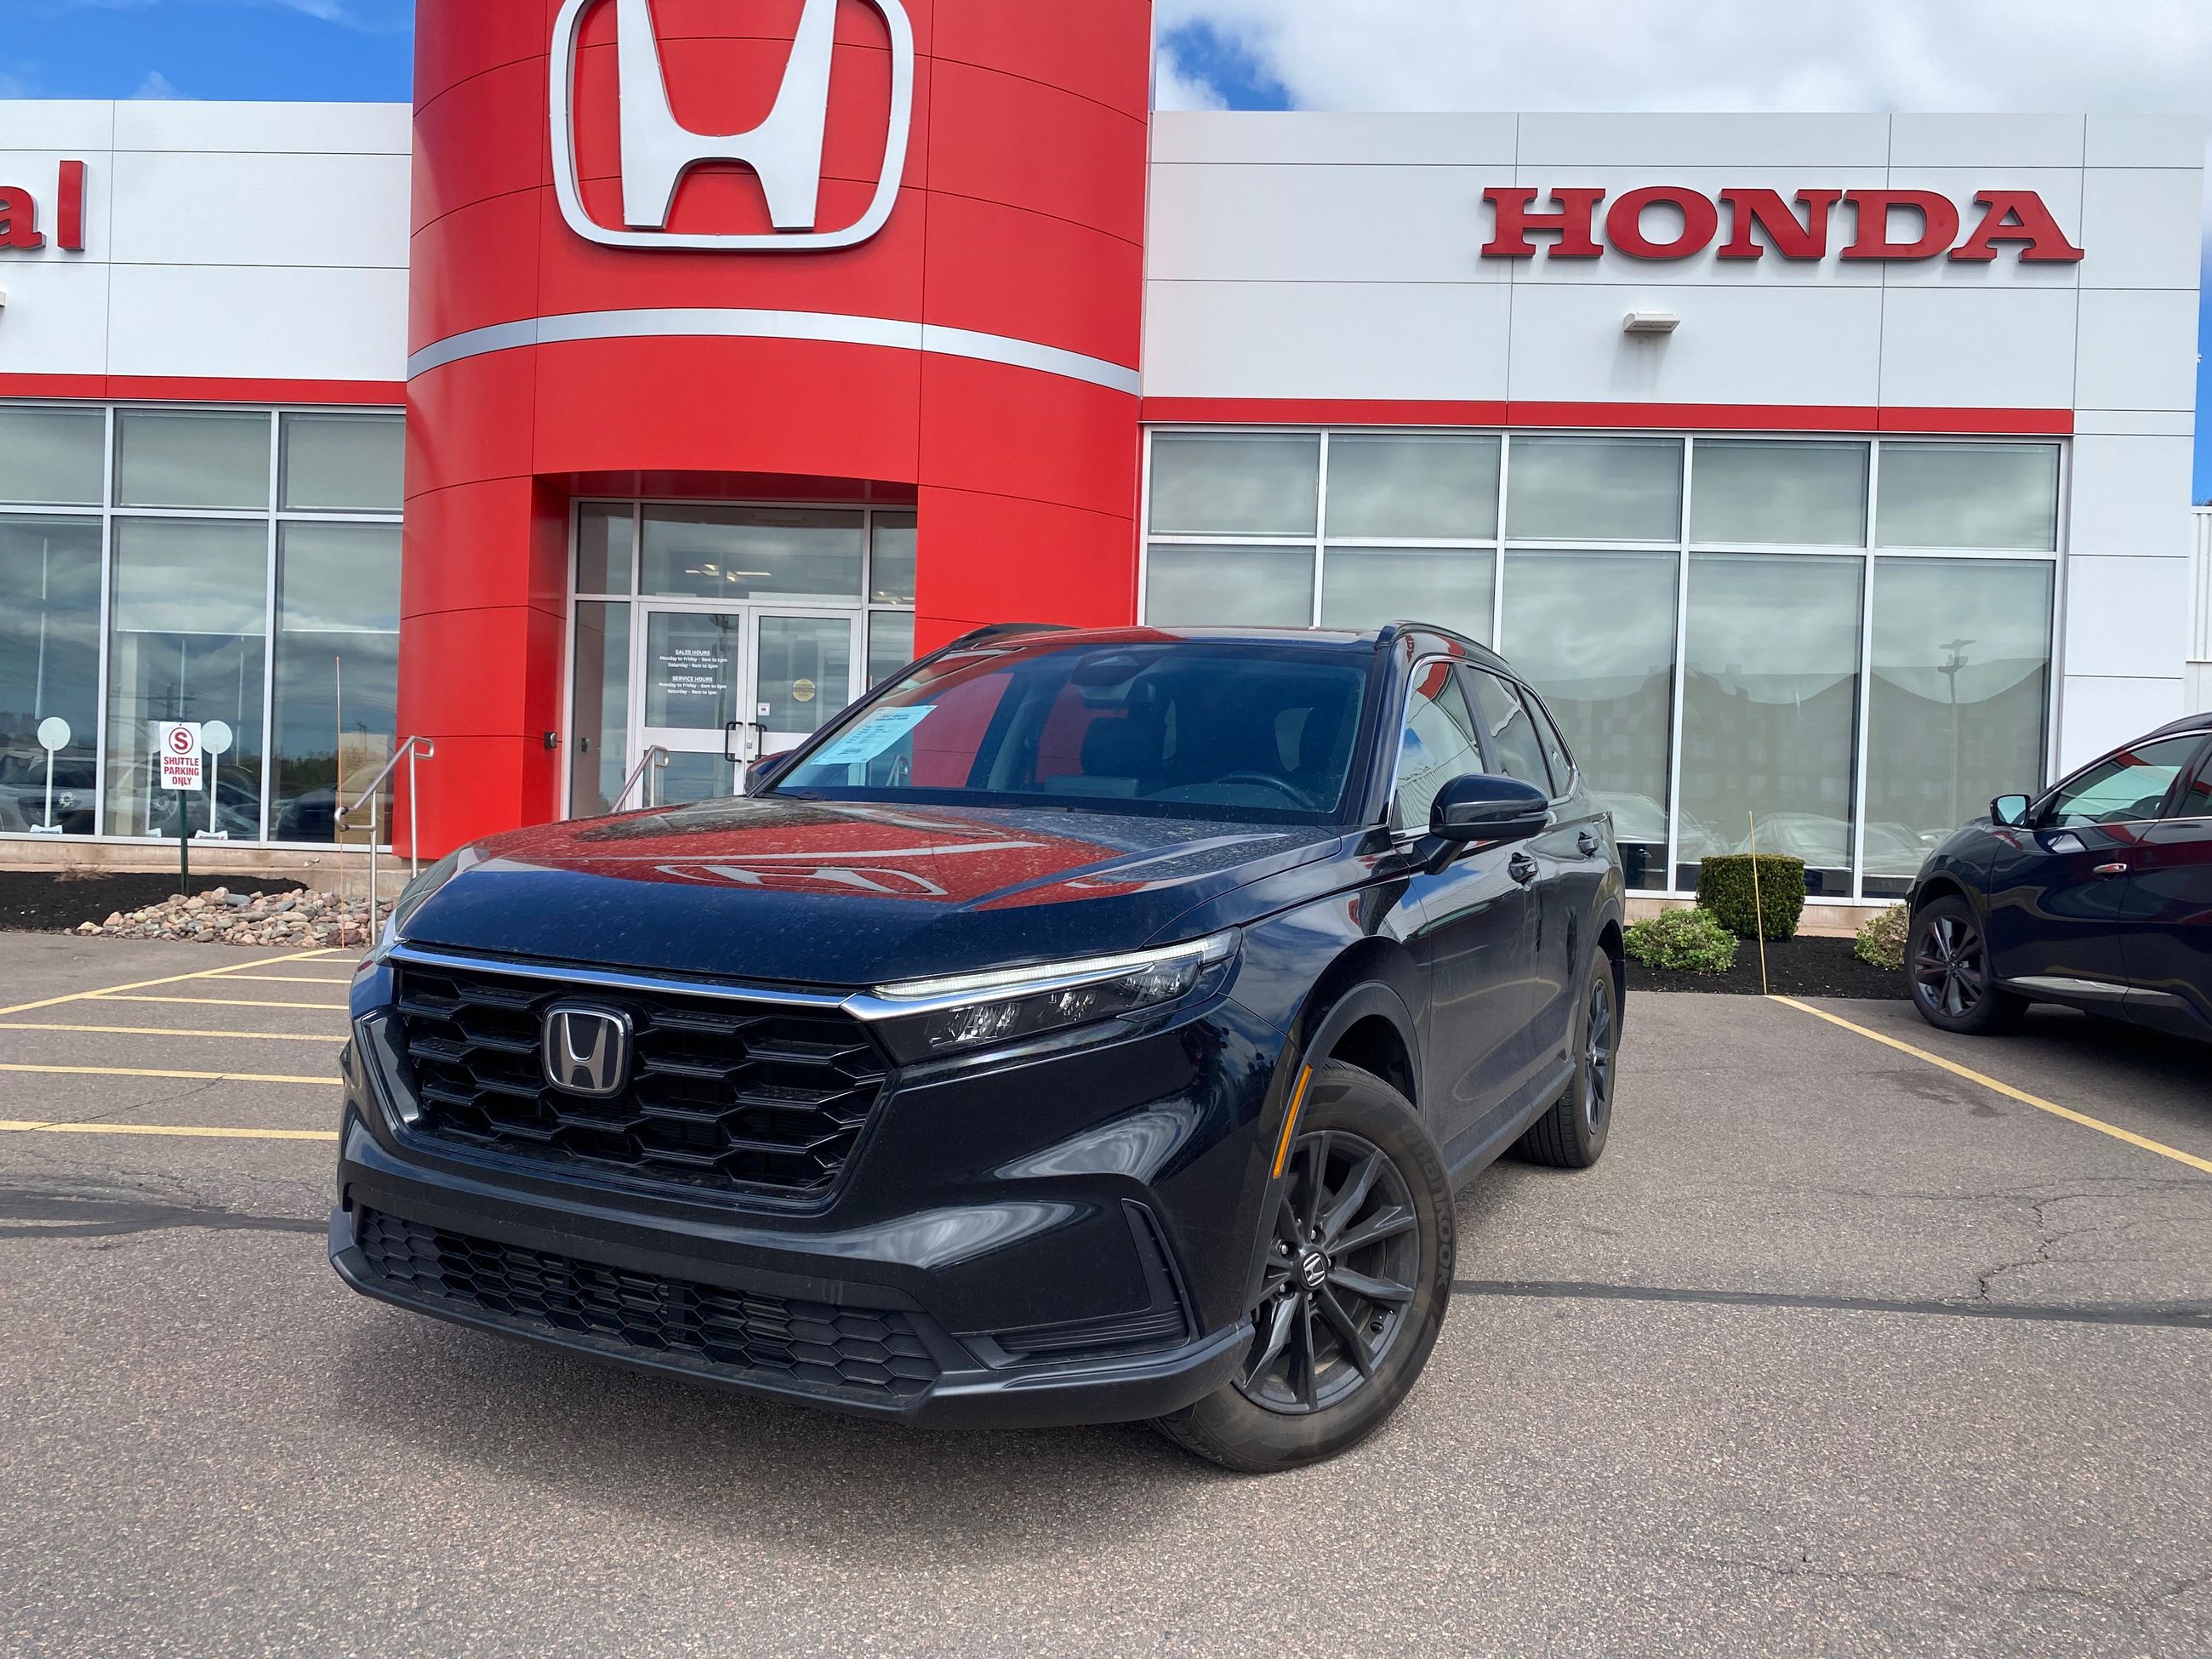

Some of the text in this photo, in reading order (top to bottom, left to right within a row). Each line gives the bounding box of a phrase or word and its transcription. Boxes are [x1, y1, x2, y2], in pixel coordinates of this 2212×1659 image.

[1481, 186, 2084, 262] HONDA
[174, 732, 188, 750] S
[163, 756, 199, 766] SHUTTLE
[164, 767, 199, 776] PARKING
[172, 776, 192, 786] ONLY
